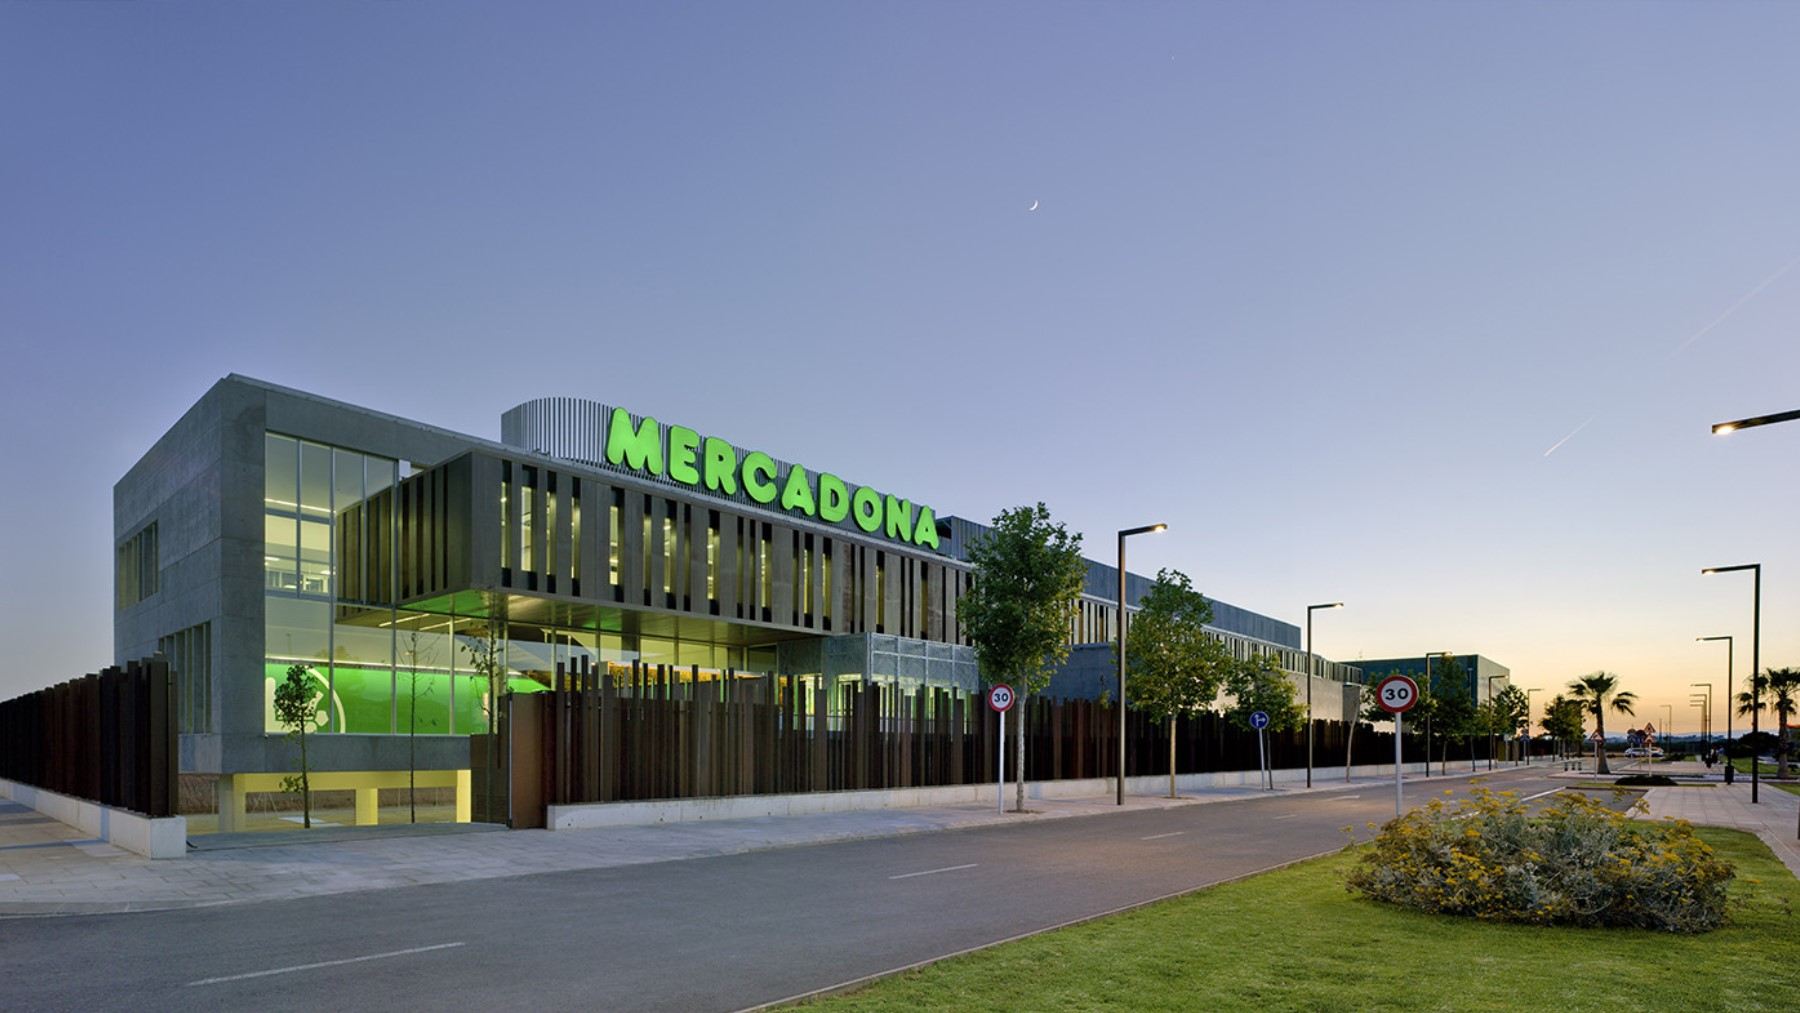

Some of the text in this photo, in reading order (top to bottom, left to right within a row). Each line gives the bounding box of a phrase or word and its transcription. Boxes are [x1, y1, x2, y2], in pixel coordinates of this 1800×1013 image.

[605, 407, 940, 550] MERCADONA
[994, 693, 1009, 703] 30
[1385, 688, 1409, 701] 30
